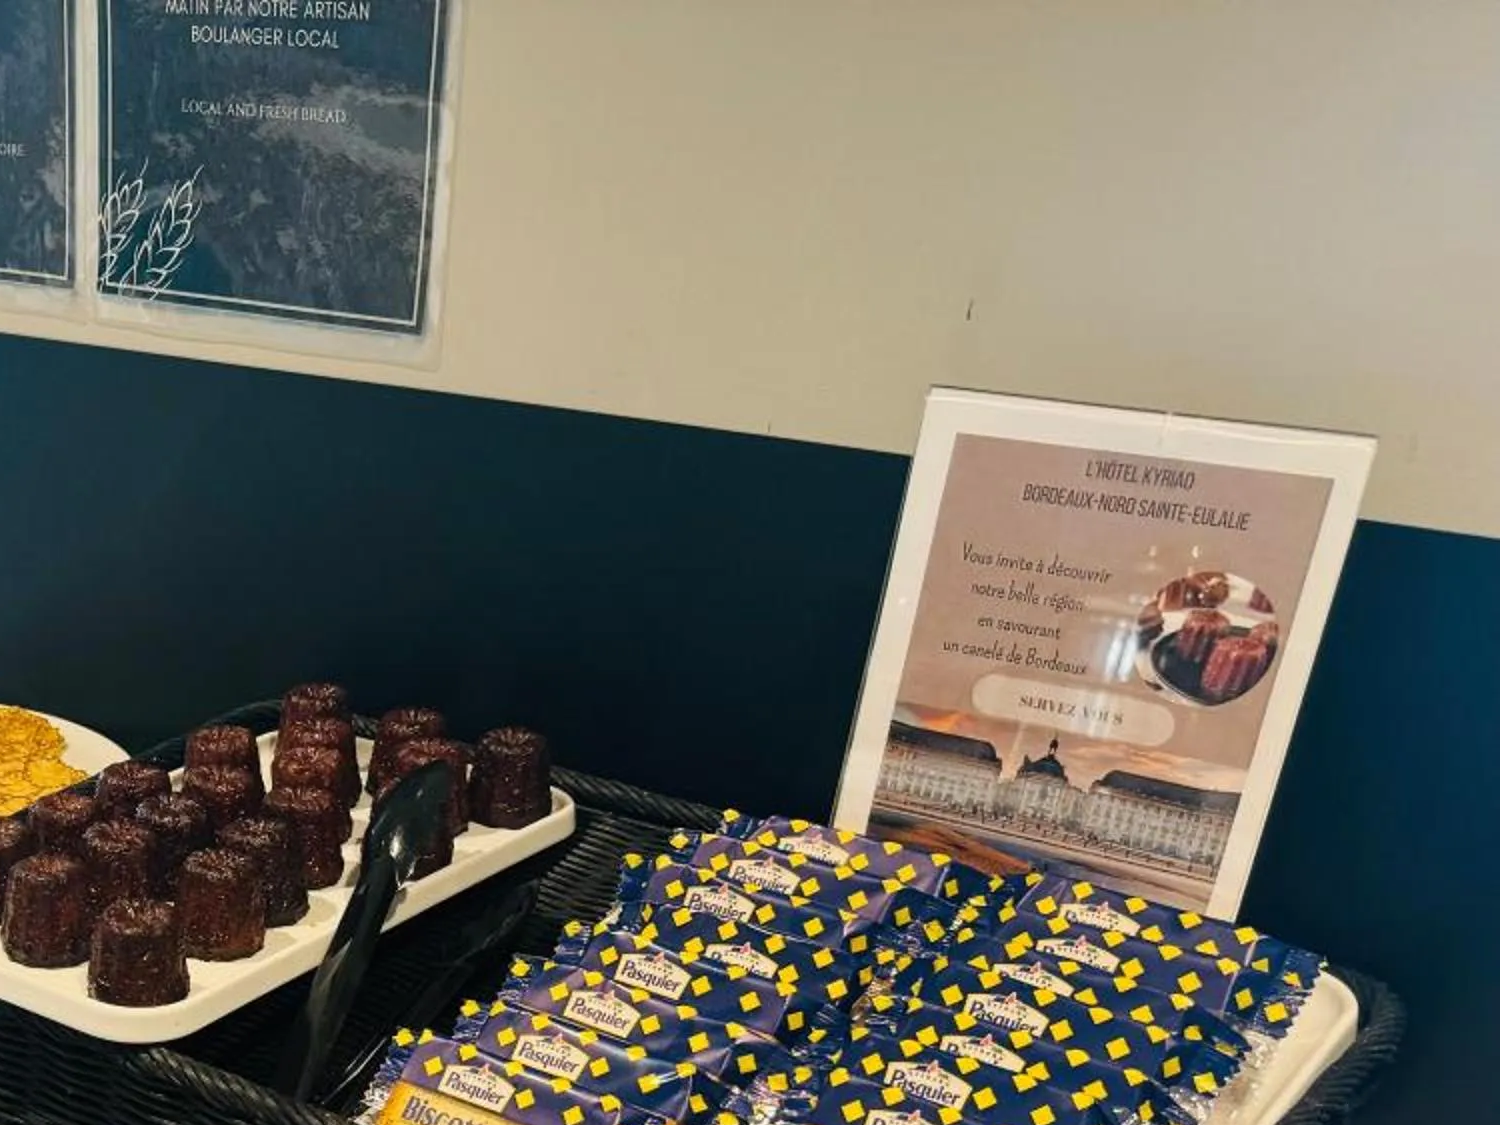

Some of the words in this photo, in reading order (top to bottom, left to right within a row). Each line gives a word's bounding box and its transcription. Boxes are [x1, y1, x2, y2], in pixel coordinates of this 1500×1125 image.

[166, 0, 209, 14] MATIN
[215, 0, 243, 16] PAR
[247, 0, 299, 18] NOTRE
[303, 1, 370, 21] ARTISAN
[191, 25, 284, 46] BOULANGER
[287, 29, 340, 49] LOCAL
[181, 97, 223, 116] LOCAL
[227, 103, 257, 118] AND
[259, 104, 298, 121] FRESH
[301, 106, 347, 123] BREAD
[1141, 469, 1196, 490] KYRIAD
[1023, 483, 1137, 515] BORDEAUX-NORD
[1137, 498, 1251, 531] SAINTE-EULALIE
[962, 541, 993, 564] Vous
[995, 553, 1034, 573] invite
[1035, 558, 1044, 574] à
[1047, 552, 1114, 584] découvrir
[970, 581, 1005, 599] notre
[1007, 579, 1040, 605] belle
[1043, 595, 1085, 615] région
[977, 615, 993, 627] en
[996, 618, 1061, 640] savourant
[943, 640, 959, 652] un
[1005, 643, 1023, 665] de
[1025, 647, 1088, 675] Bordeaux
[621, 959, 680, 993] Pasquier
[571, 996, 631, 1031] Pasquier
[519, 1041, 581, 1074] Pasquier
[446, 1071, 504, 1105] Pasquier
[891, 1069, 961, 1105] Pasquier
